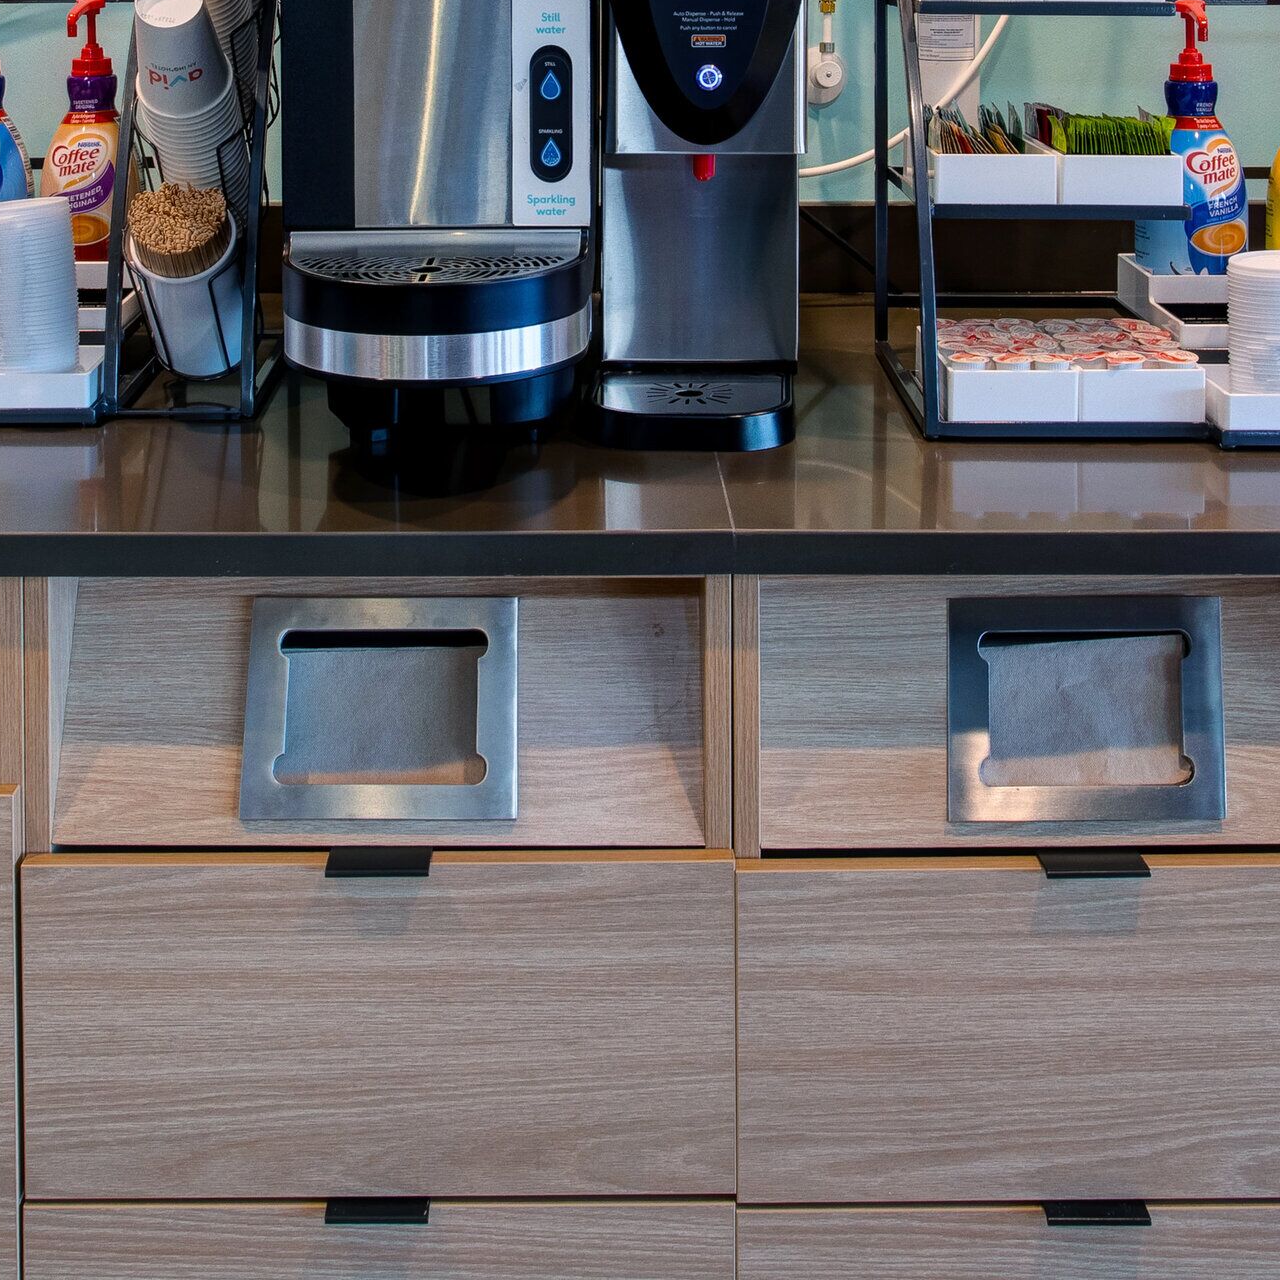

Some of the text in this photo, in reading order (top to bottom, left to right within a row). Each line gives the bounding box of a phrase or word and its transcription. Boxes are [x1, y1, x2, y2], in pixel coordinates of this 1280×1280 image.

[541, 13, 561, 22] Still
[536, 26, 566, 34] water
[52, 145, 100, 167] Coffee
[1186, 151, 1235, 174] Coffee
[59, 160, 96, 177] mate
[1203, 167, 1236, 184] mate
[527, 194, 576, 206] Sparkling
[1208, 196, 1238, 210] FRENCH
[536, 208, 567, 216] water
[1209, 204, 1239, 217] VANILLA
